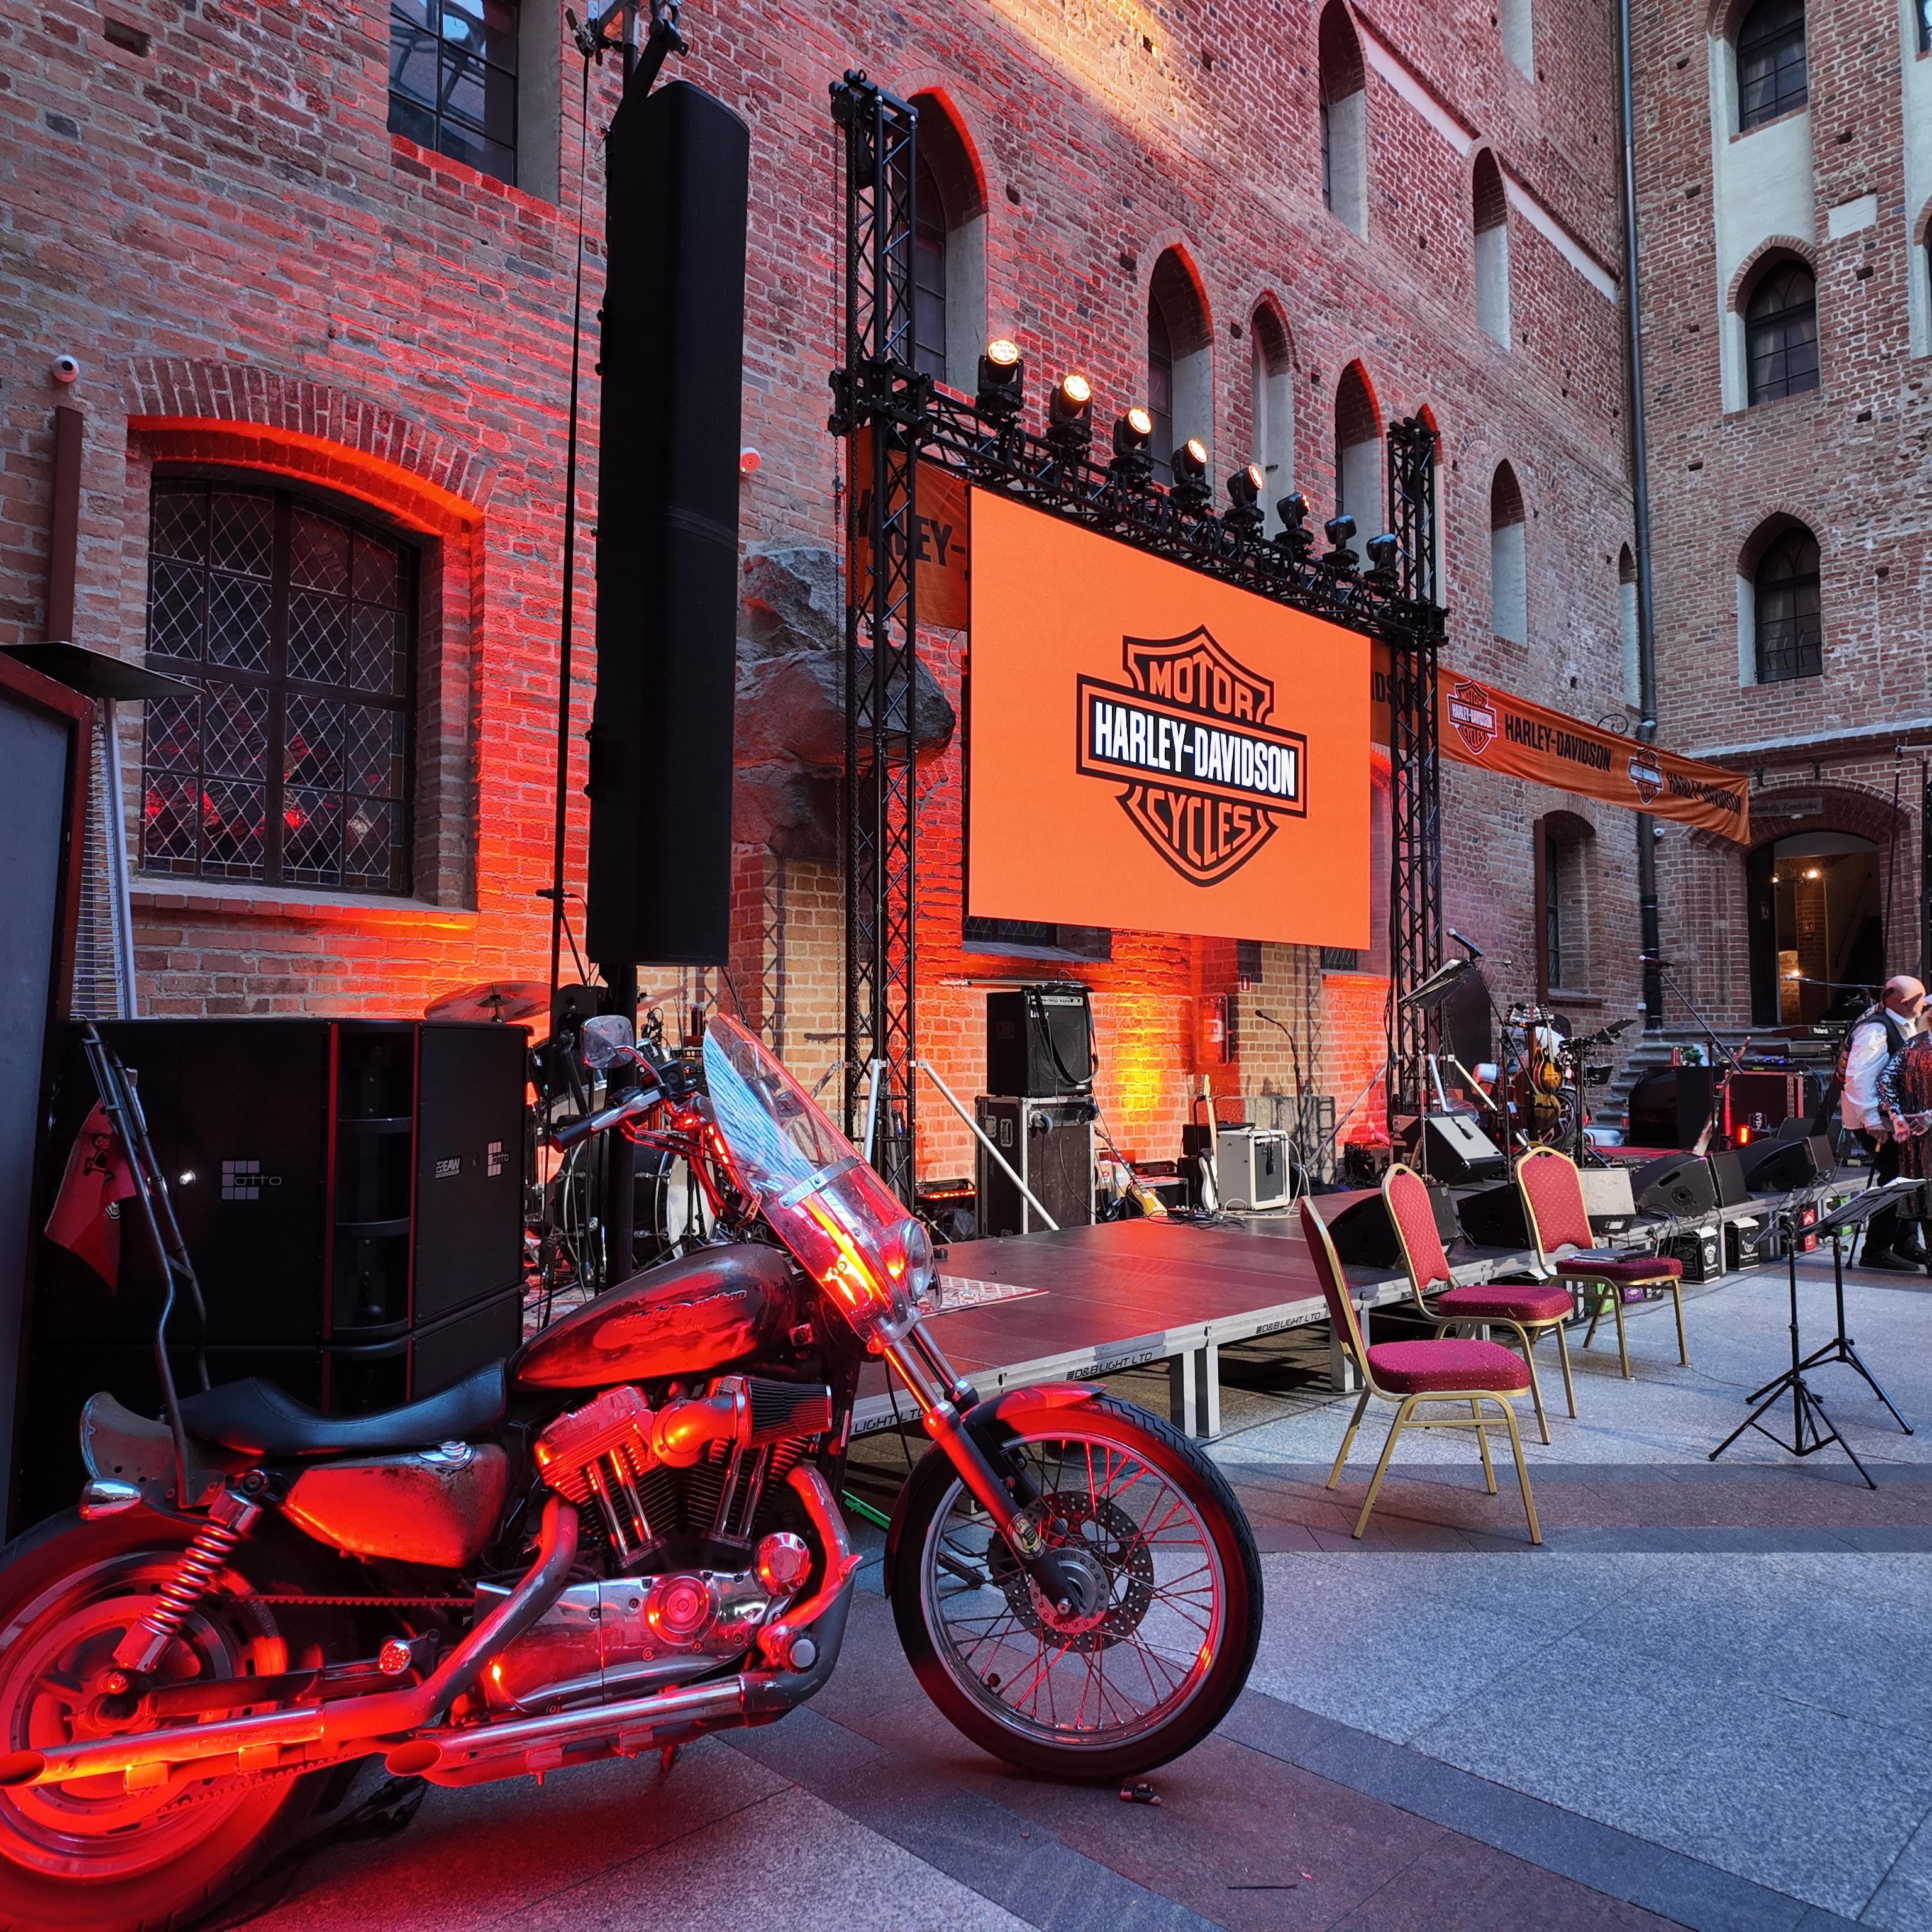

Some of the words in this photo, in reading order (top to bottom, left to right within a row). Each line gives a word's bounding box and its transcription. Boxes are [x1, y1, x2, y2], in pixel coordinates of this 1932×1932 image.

[1150, 650, 1253, 721] MOTOR
[1460, 689, 1485, 707] MOTOR
[1451, 702, 1493, 729] HARLEY-DAVIDSON
[1095, 701, 1295, 796] HARLEY-DAVIDSON
[1461, 725, 1485, 747] CYCLES
[1504, 713, 1613, 772] HARLEY-DAVIDSON
[1667, 770, 1741, 816] HARLEY-DAVIDSON
[1146, 787, 1252, 867] CYCLES
[492, 1153, 509, 1164] otto
[235, 1174, 282, 1186] otto
[1262, 1321, 1280, 1333] D&B
[1280, 1316, 1303, 1328] LIGHT
[1305, 1312, 1321, 1322] LTD
[1074, 1365, 1098, 1379] D&B
[1099, 1357, 1130, 1372] LIGHT
[1131, 1352, 1153, 1364] LTD
[854, 1413, 897, 1433] LIGHT
